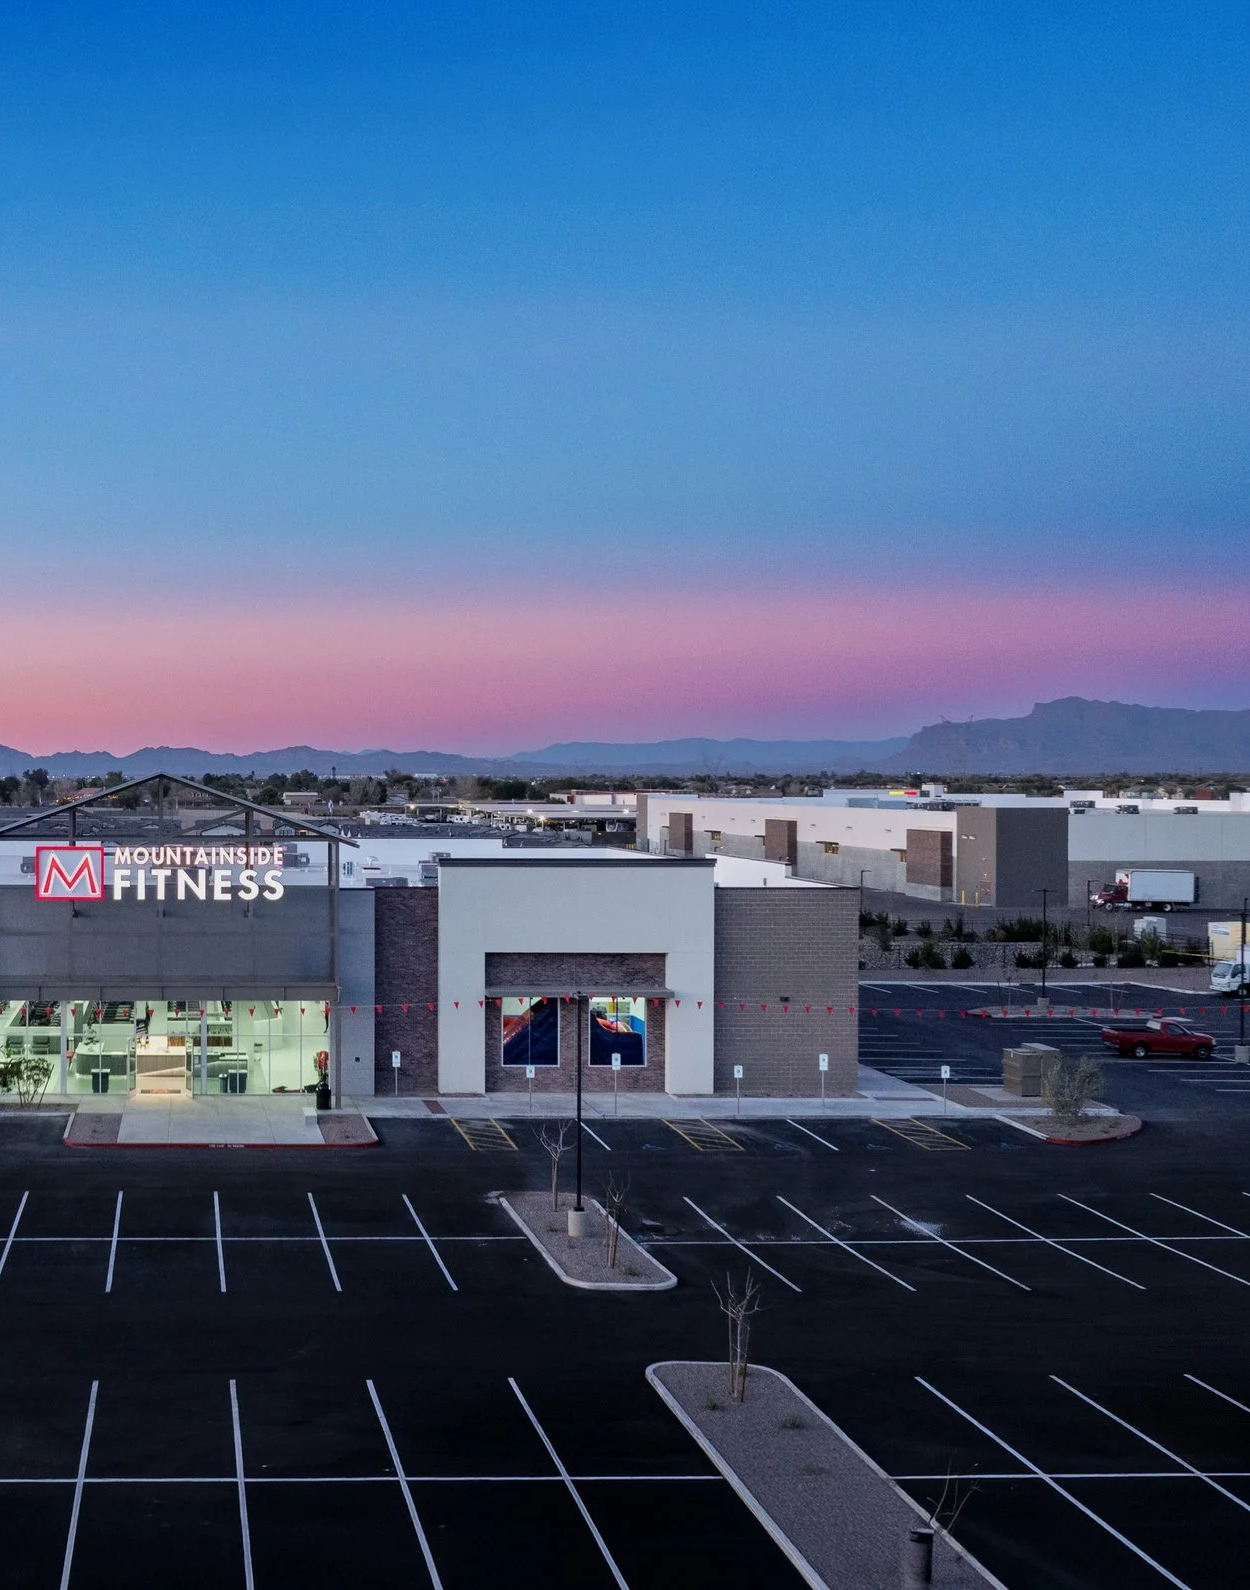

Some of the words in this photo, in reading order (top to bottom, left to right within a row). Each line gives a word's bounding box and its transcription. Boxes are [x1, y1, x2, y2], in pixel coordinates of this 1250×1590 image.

[114, 846, 283, 865] MOUNTAINSIDE
[41, 850, 99, 895] M
[113, 869, 285, 900] FITNESS
